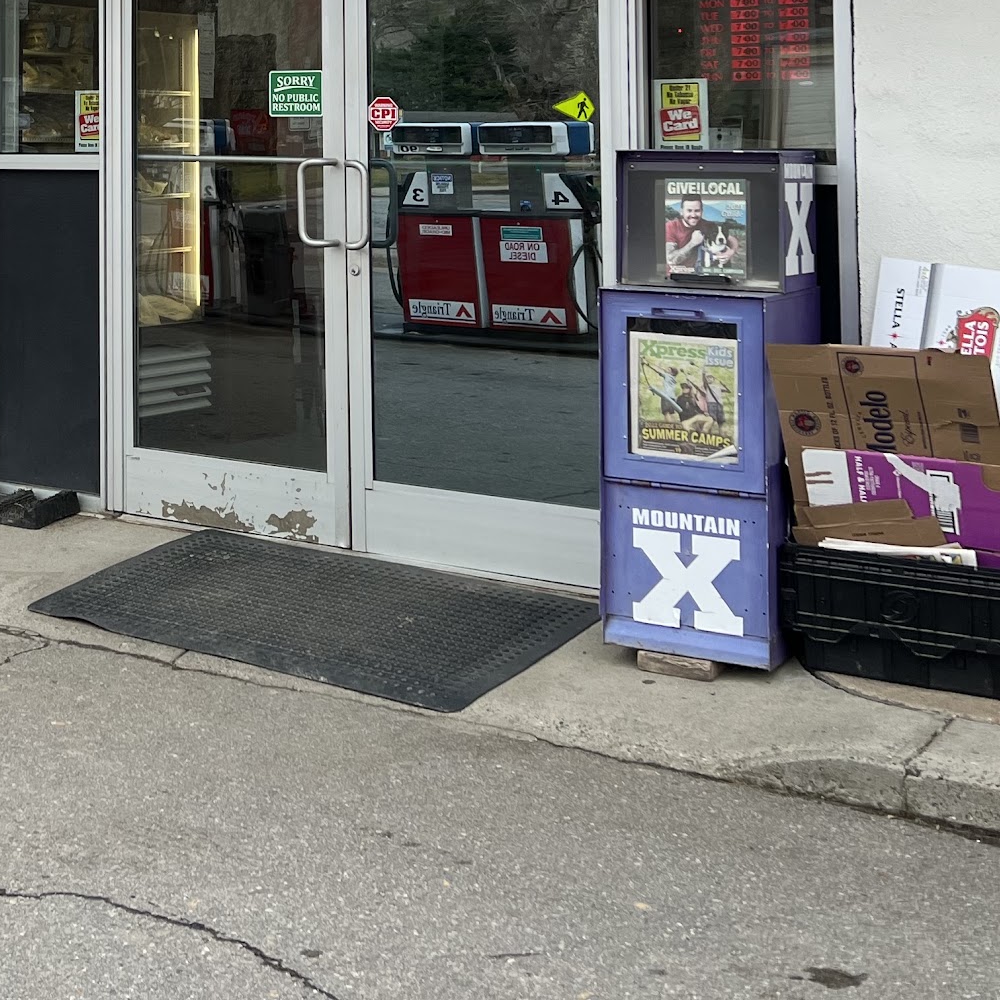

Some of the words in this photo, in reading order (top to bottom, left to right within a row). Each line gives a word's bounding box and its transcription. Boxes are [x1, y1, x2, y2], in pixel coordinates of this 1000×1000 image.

[276, 76, 315, 88] SORRY
[272, 93, 286, 102] NO
[287, 93, 319, 103] PUBLIC
[272, 102, 321, 112] RESTROOM
[371, 109, 396, 119] CPI
[84, 115, 99, 124] We
[667, 109, 692, 121] We
[81, 124, 99, 133] Car
[663, 118, 699, 132] Card
[667, 181, 744, 195] GIVE!LOCAL
[784, 182, 815, 276] X
[891, 287, 905, 329] STELLA
[960, 321, 976, 355] ELLA
[973, 321, 989, 355] TOIS
[640, 339, 706, 359] Xpress
[708, 345, 733, 358] Kids
[642, 428, 688, 441] SUMMER
[691, 430, 732, 447] CAMPS
[854, 455, 864, 475] HALF
[632, 508, 740, 536] MOUNTAIN
[633, 527, 744, 636] X
